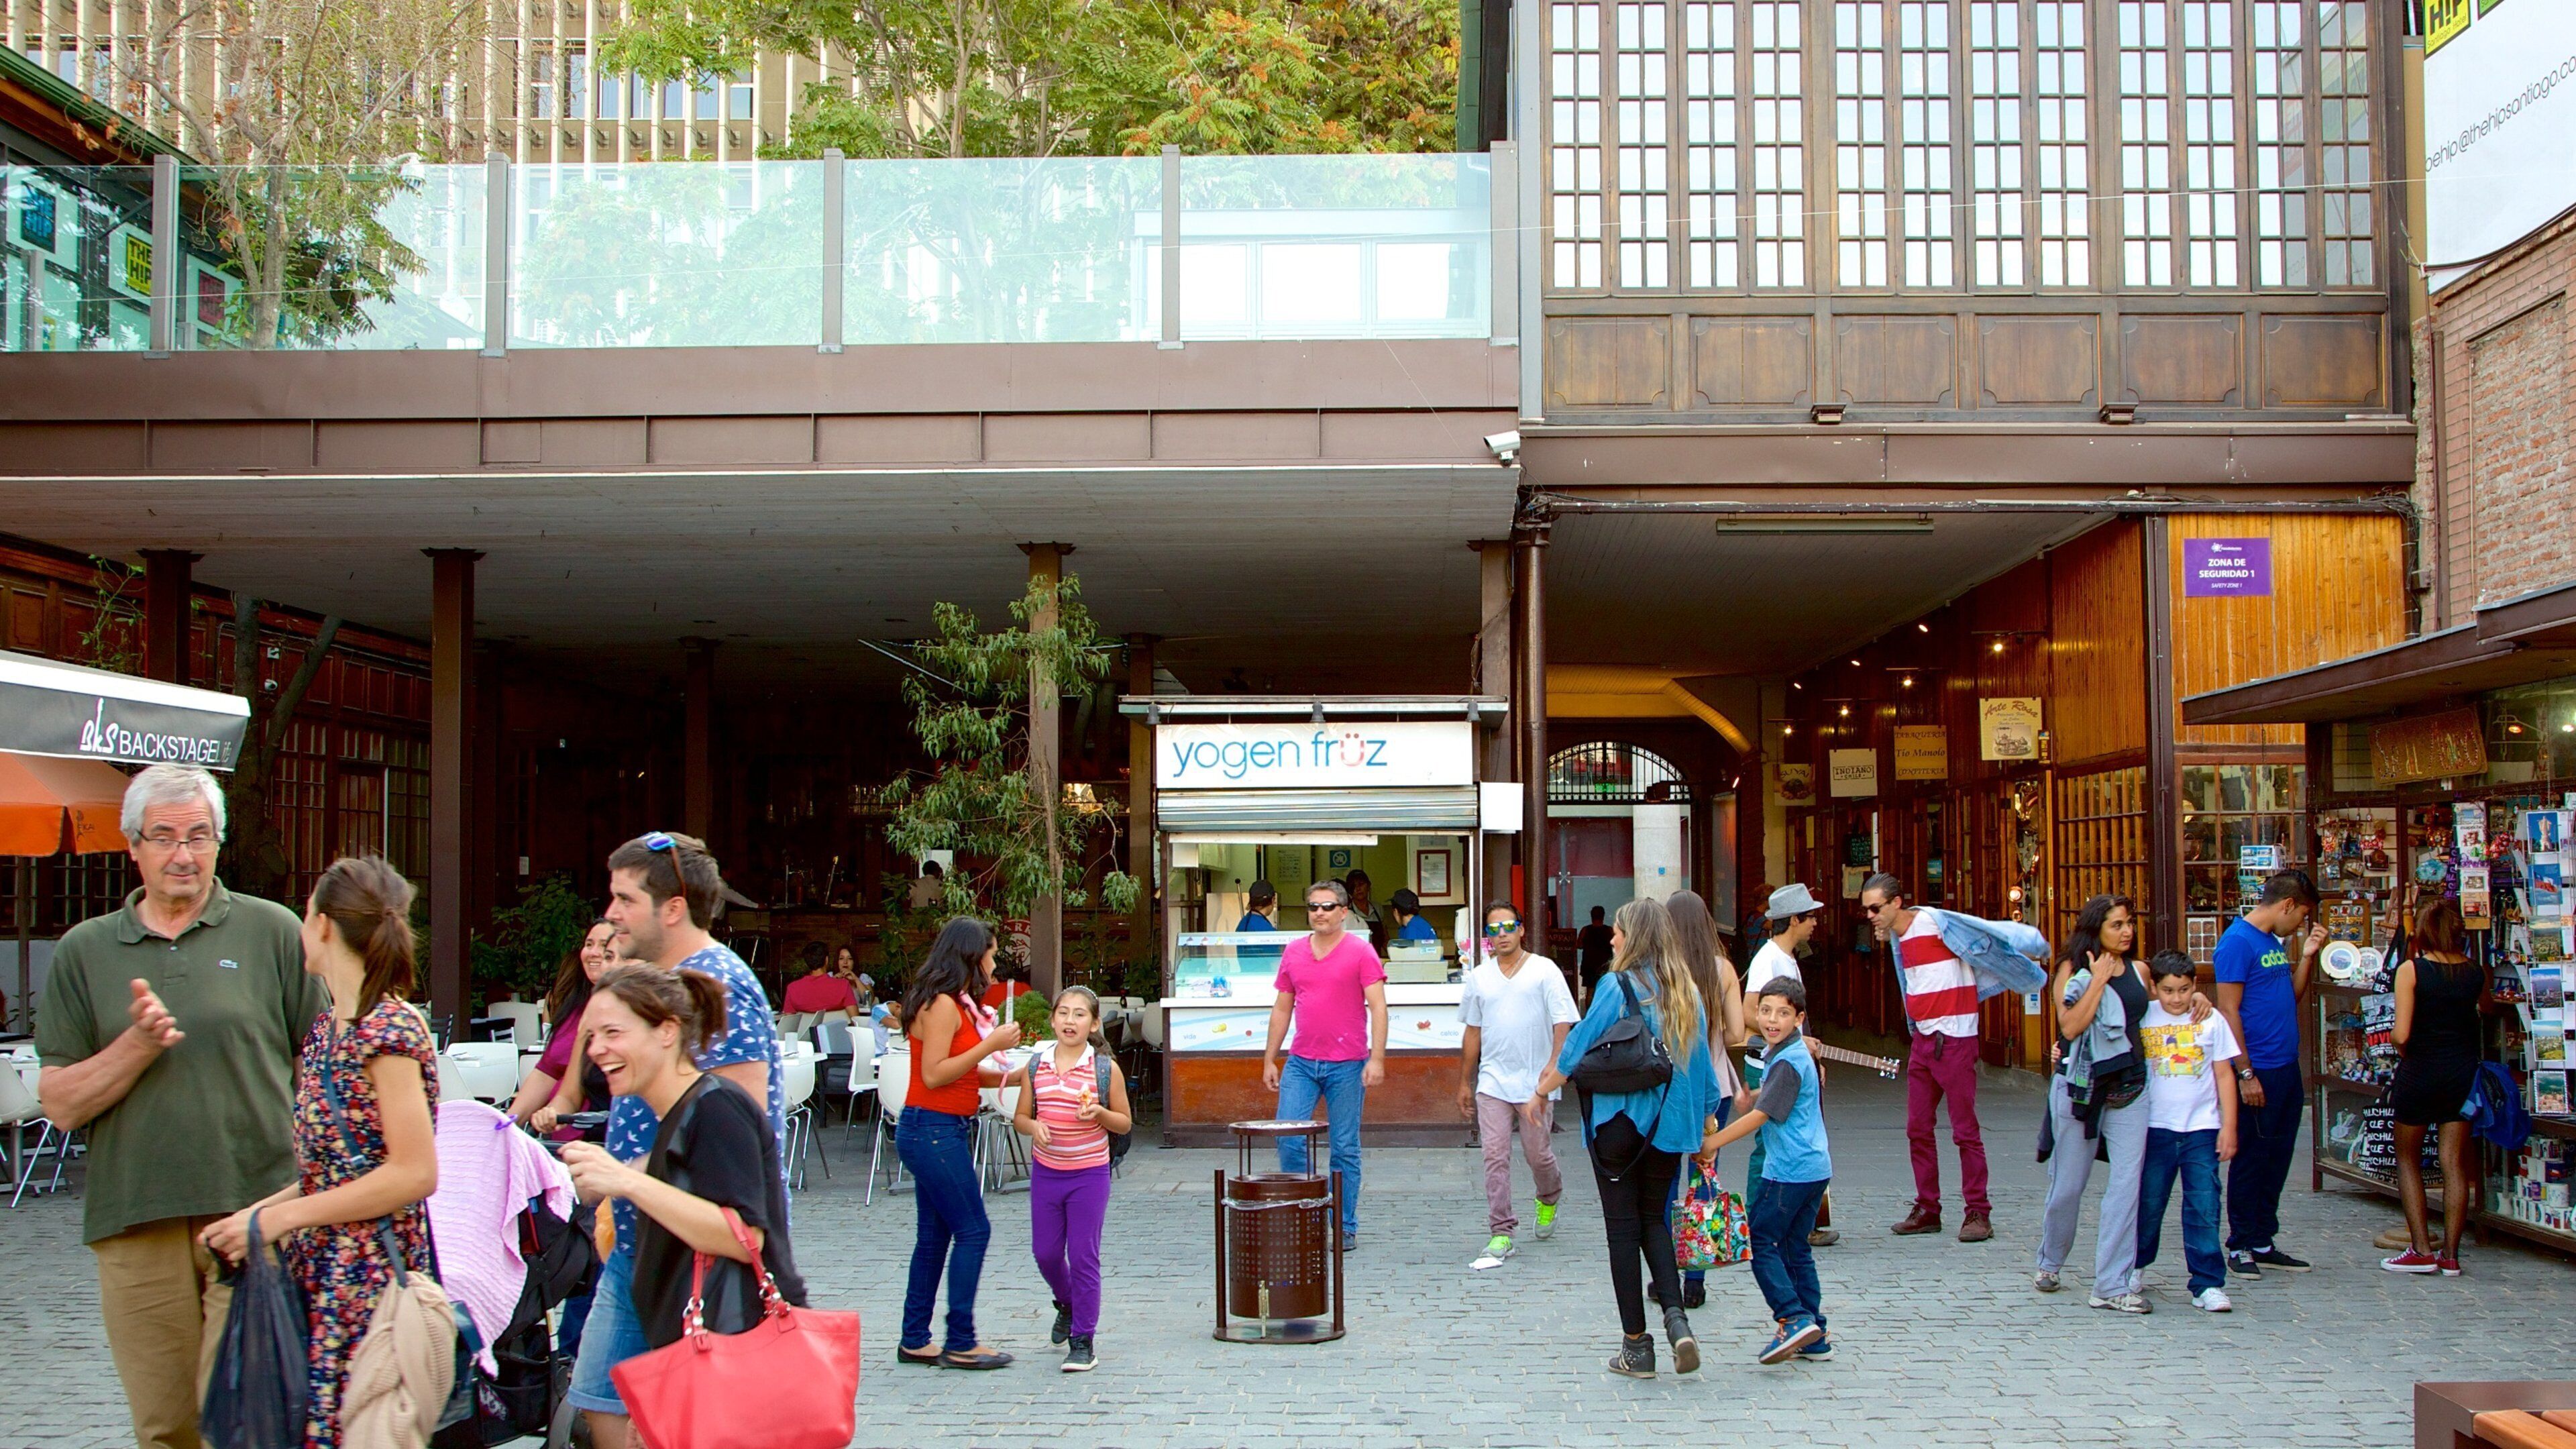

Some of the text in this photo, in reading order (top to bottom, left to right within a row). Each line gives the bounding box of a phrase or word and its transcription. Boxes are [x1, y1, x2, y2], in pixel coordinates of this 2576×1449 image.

[2427, 12, 2467, 49] Santiago Hotel
[129, 239, 152, 266] THE
[2208, 558, 2246, 567] ZONA DE
[2199, 570, 2255, 578] SEGURIDAD 1
[2012, 700, 2038, 718] Rosa
[119, 730, 219, 763] BACKSTAGE
[1173, 731, 1387, 779] yogen früz
[1913, 747, 1945, 757] Manolo
